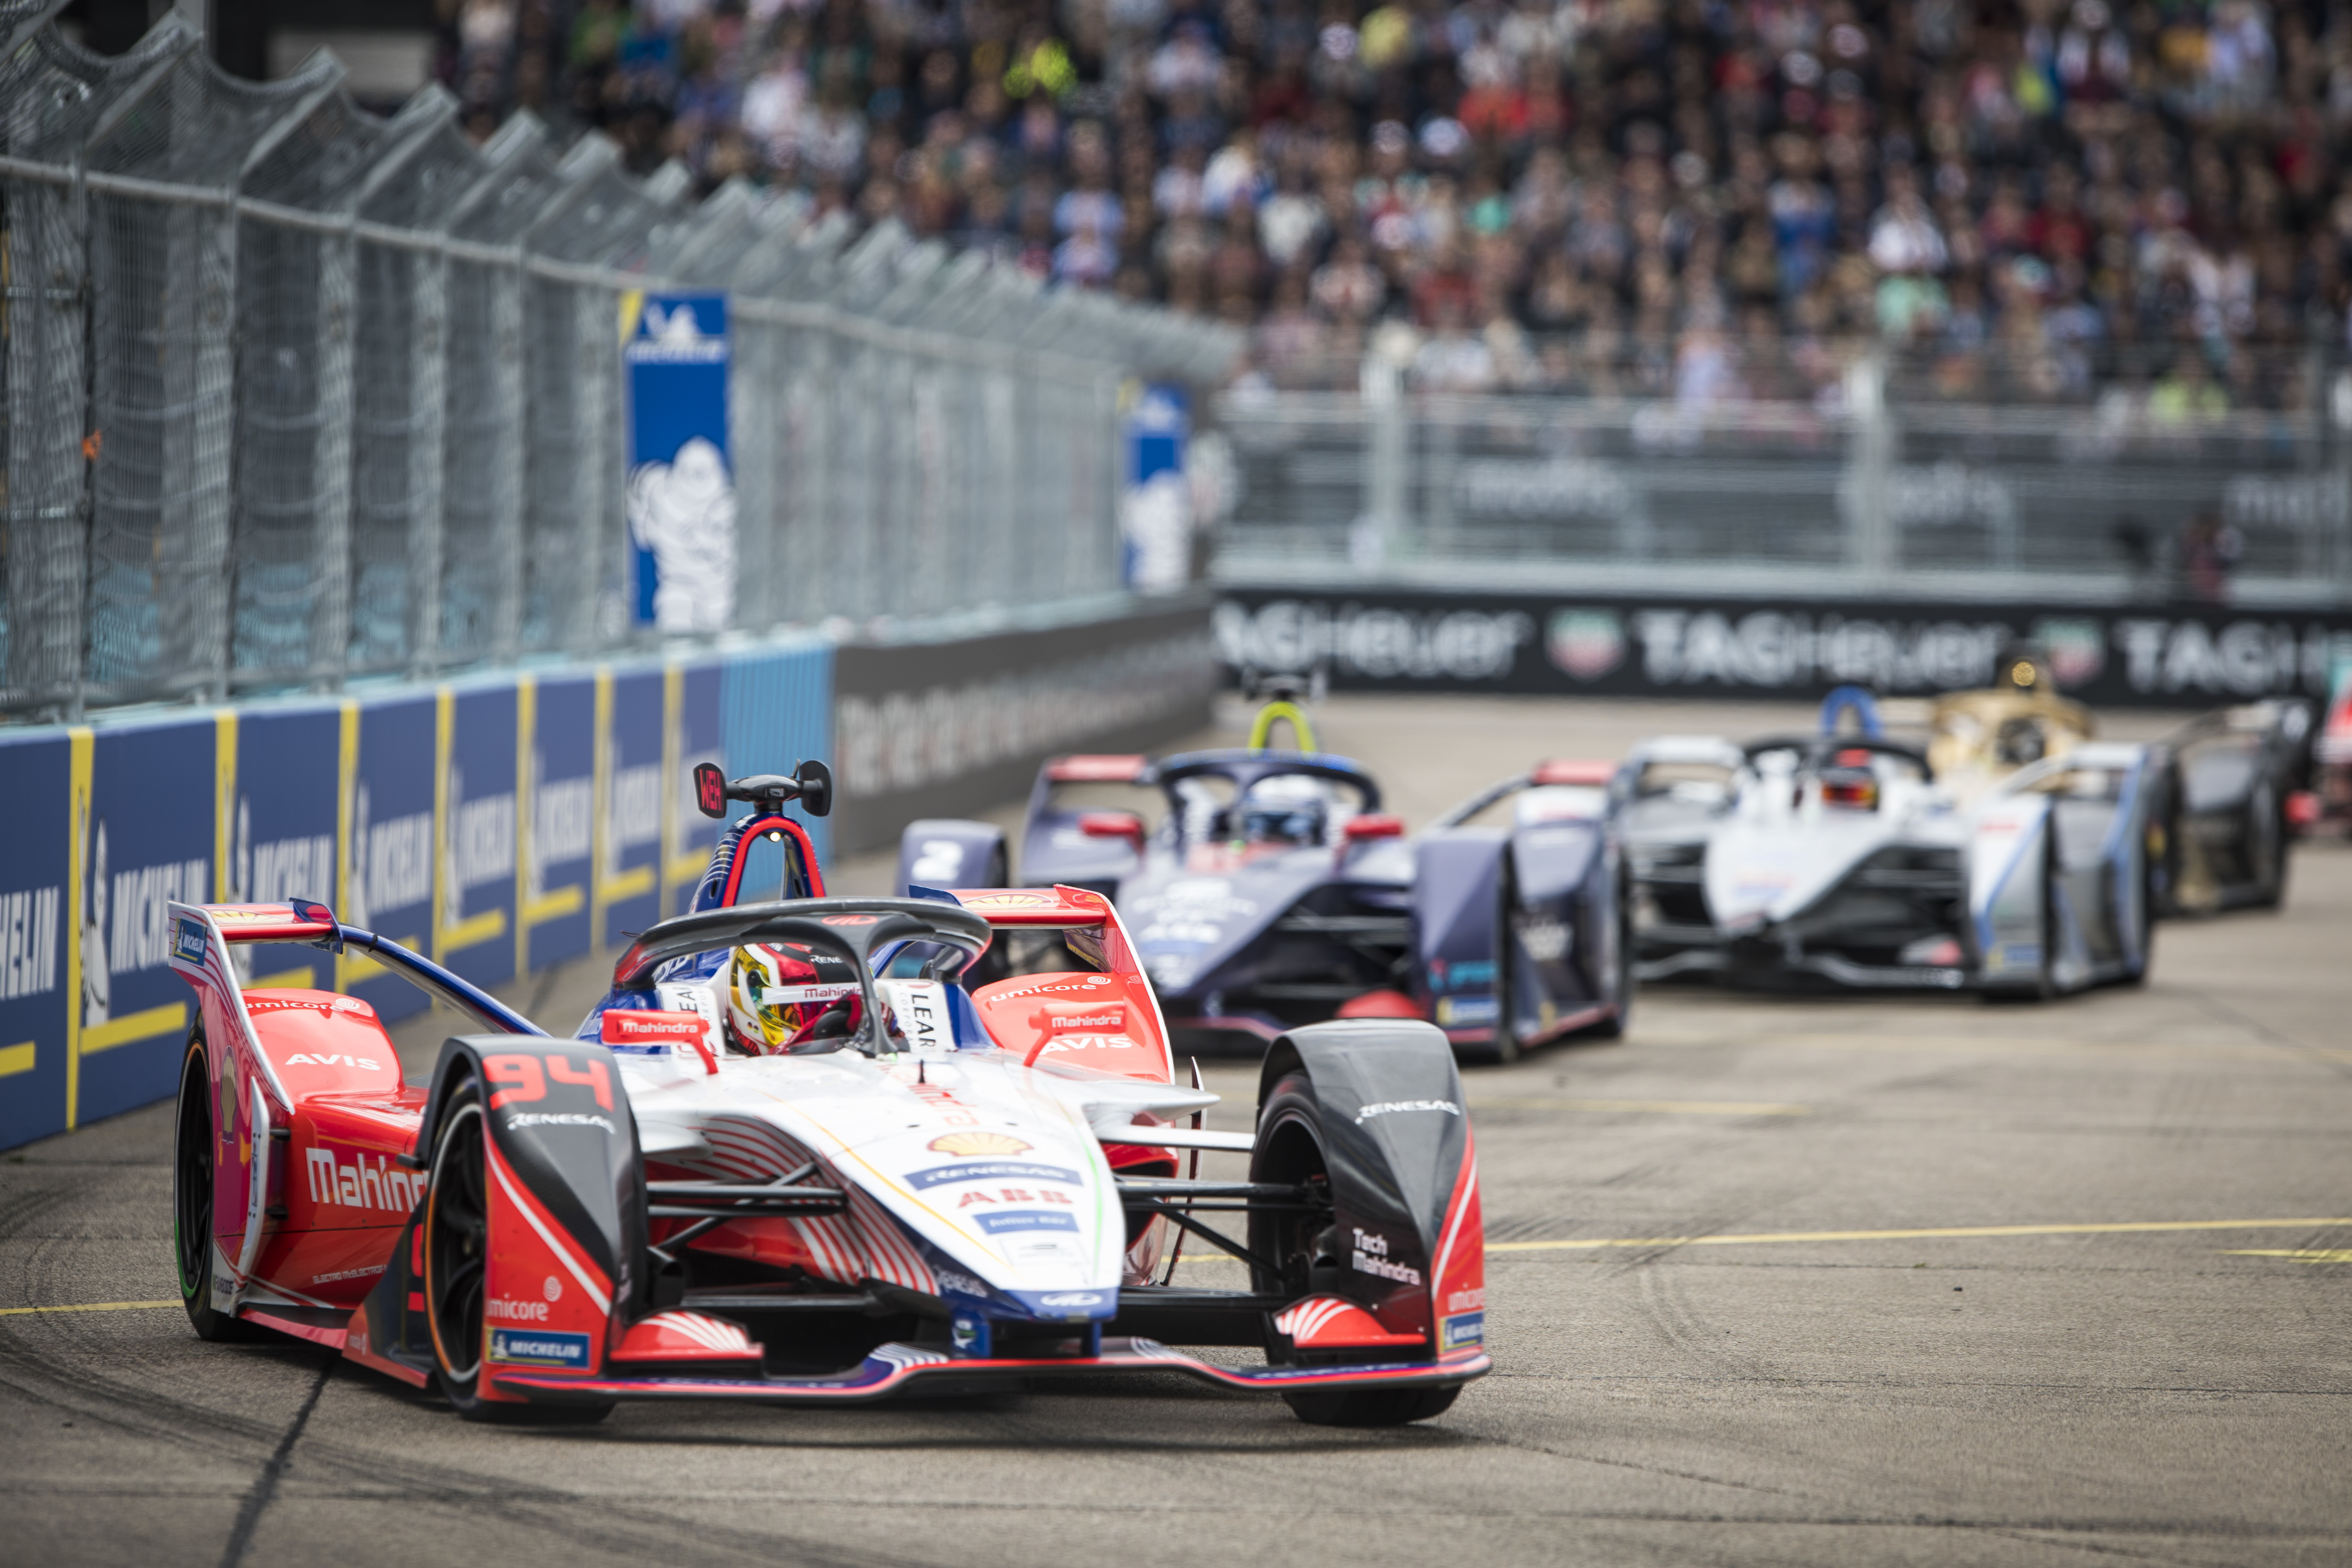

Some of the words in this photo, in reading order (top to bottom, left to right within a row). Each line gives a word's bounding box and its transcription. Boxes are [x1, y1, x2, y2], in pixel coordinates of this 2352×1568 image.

[699, 769, 721, 811] WEH
[182, 934, 205, 954] MICHELIN
[808, 955, 845, 965] RENE
[805, 987, 861, 998] Mahinr
[990, 984, 1097, 1002] umicore
[623, 1022, 698, 1033] Mahindra
[911, 994, 936, 1047] LEAR
[1052, 1014, 1121, 1028] Mahindra
[1038, 1037, 1132, 1056] AVIS
[285, 1053, 381, 1071] AVIS
[482, 1054, 615, 1113] 94
[1354, 1099, 1460, 1125] RENESAS
[306, 1147, 429, 1213] Mahin
[925, 1164, 1066, 1182] RENESAS
[957, 1188, 1073, 1209] ABB
[1352, 1227, 1388, 1256] Tech
[1352, 1249, 1421, 1286] Mahindra
[509, 1340, 581, 1359] MICHELIN
